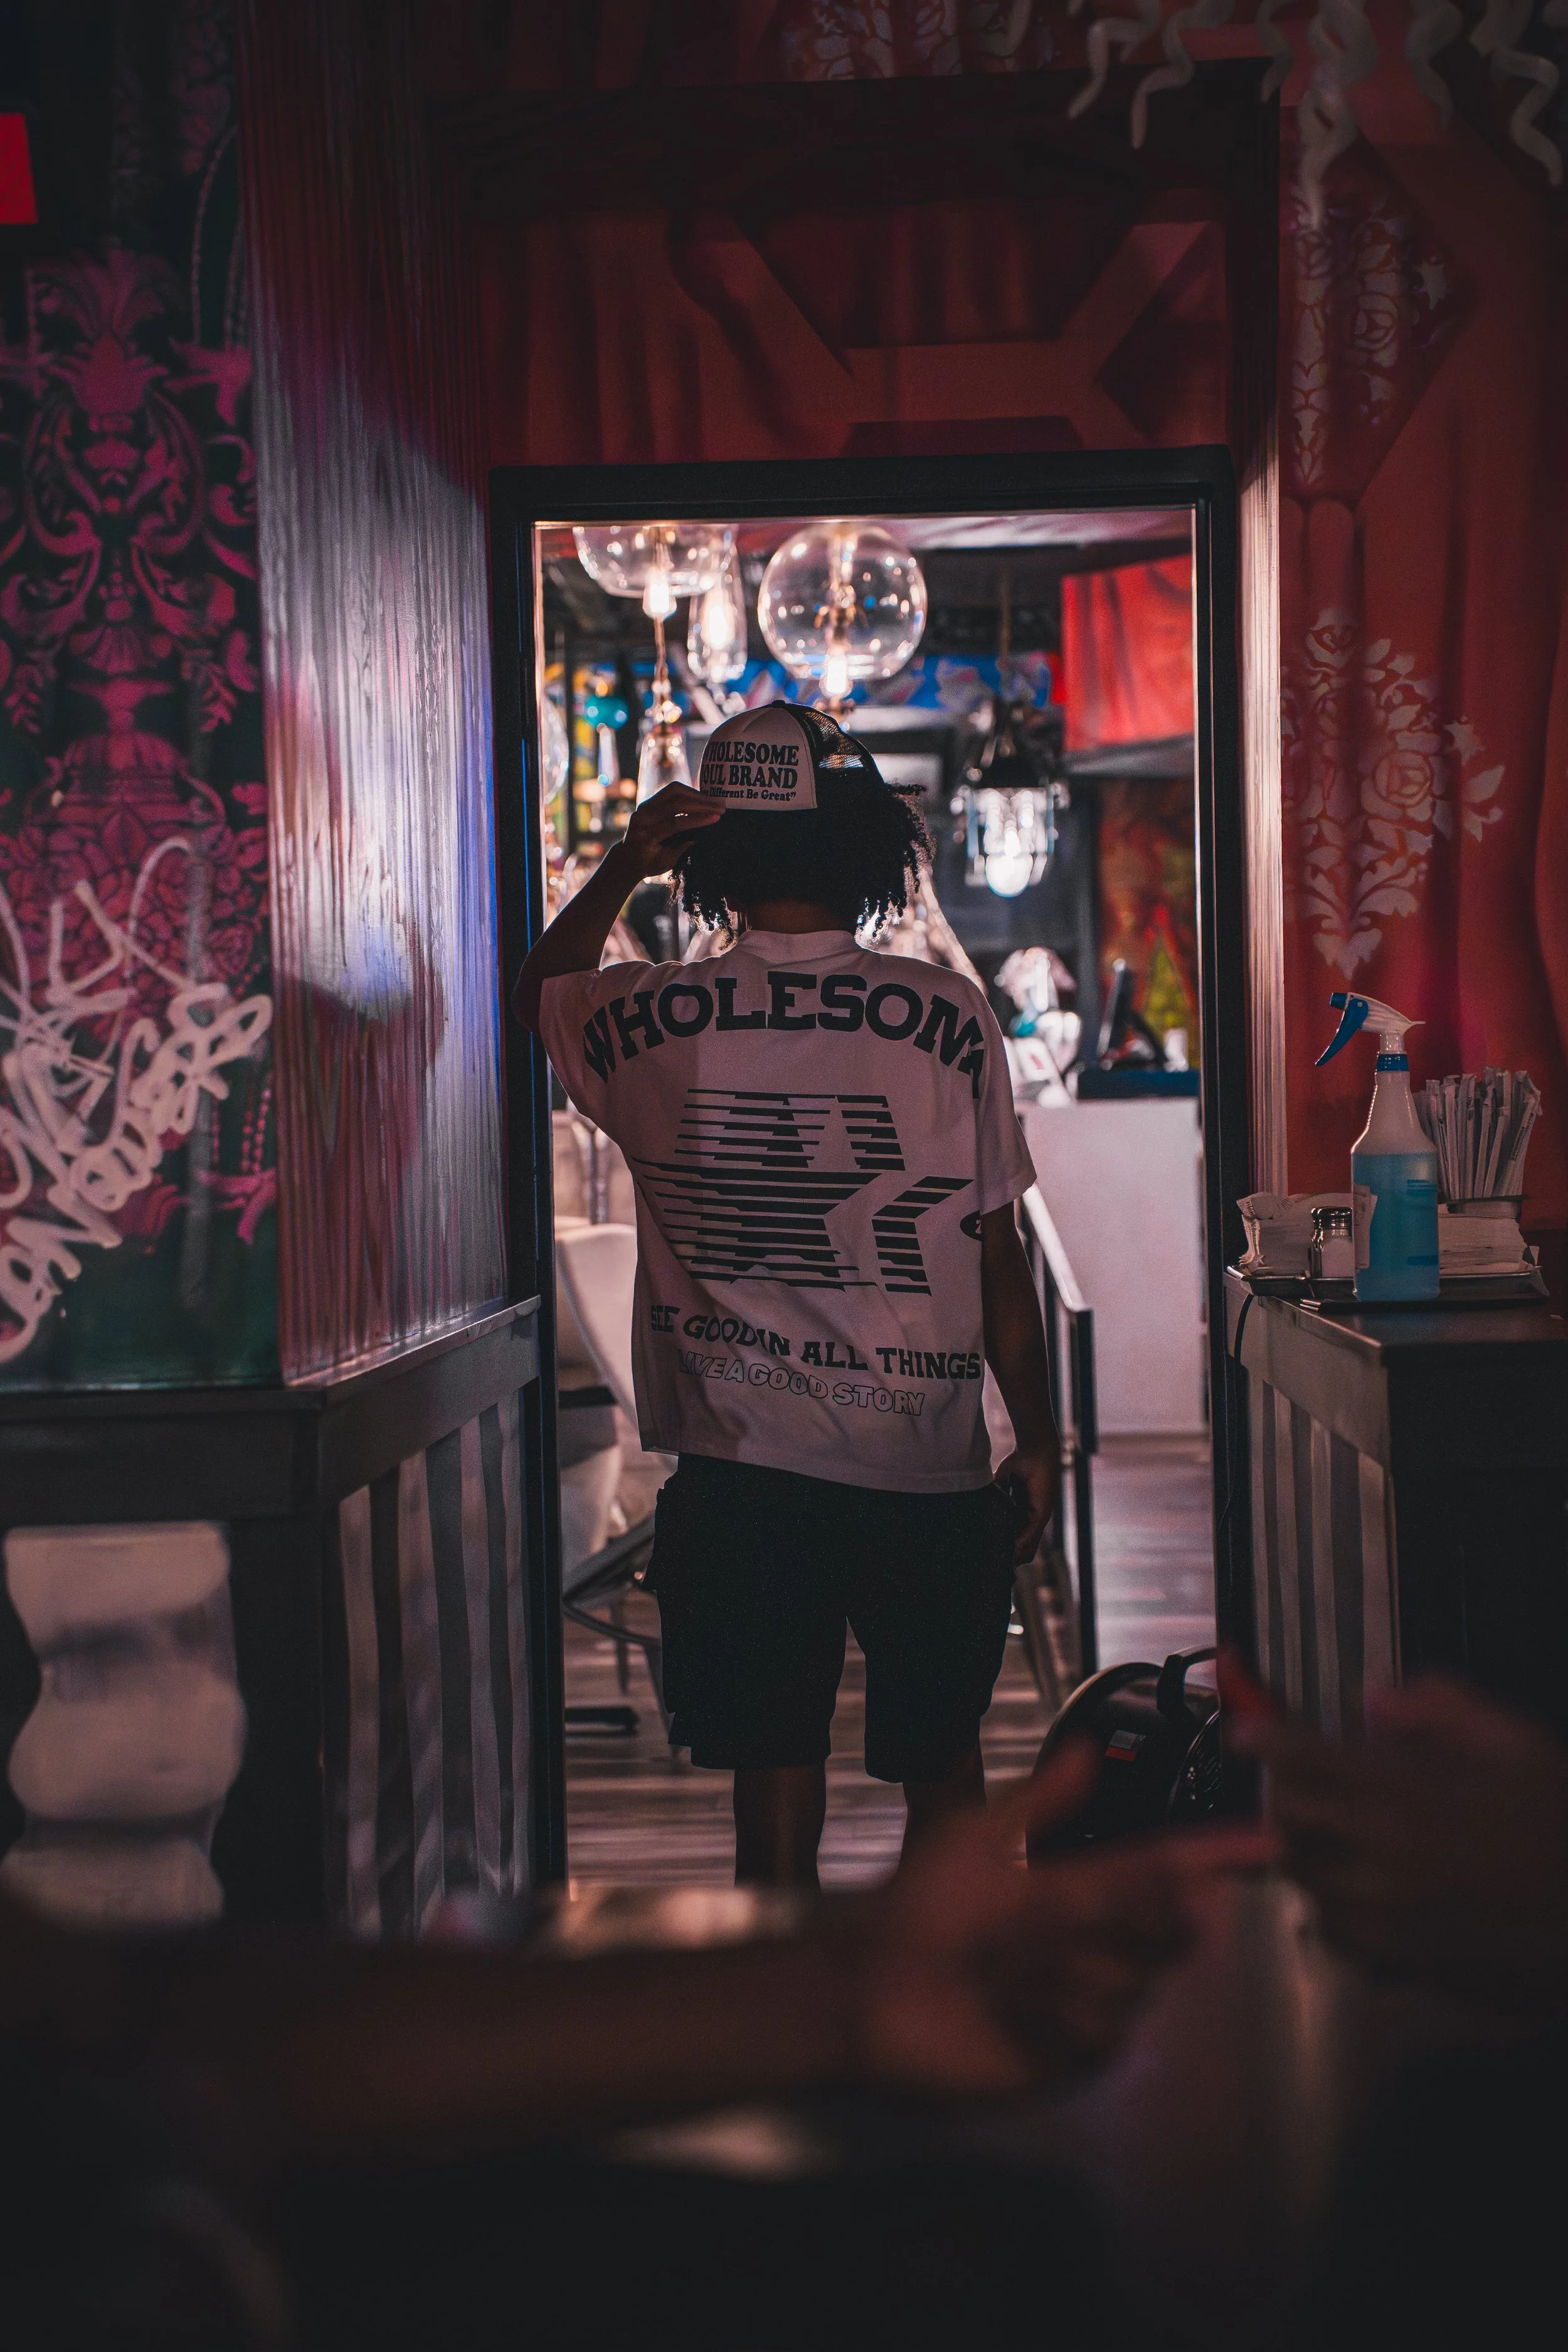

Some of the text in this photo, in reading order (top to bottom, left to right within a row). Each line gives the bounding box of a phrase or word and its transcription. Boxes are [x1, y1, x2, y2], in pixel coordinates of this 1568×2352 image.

[709, 787, 744, 798] Different
[746, 788, 758, 799] Be
[728, 765, 798, 789] BRAND
[683, 1314, 758, 1347] GOOD
[756, 1328, 790, 1356] IN
[800, 1340, 868, 1371] ALL
[876, 1347, 981, 1380] THINGS
[724, 1359, 744, 1384] A
[748, 1363, 828, 1399] GOOD
[833, 1382, 925, 1416] STORY
